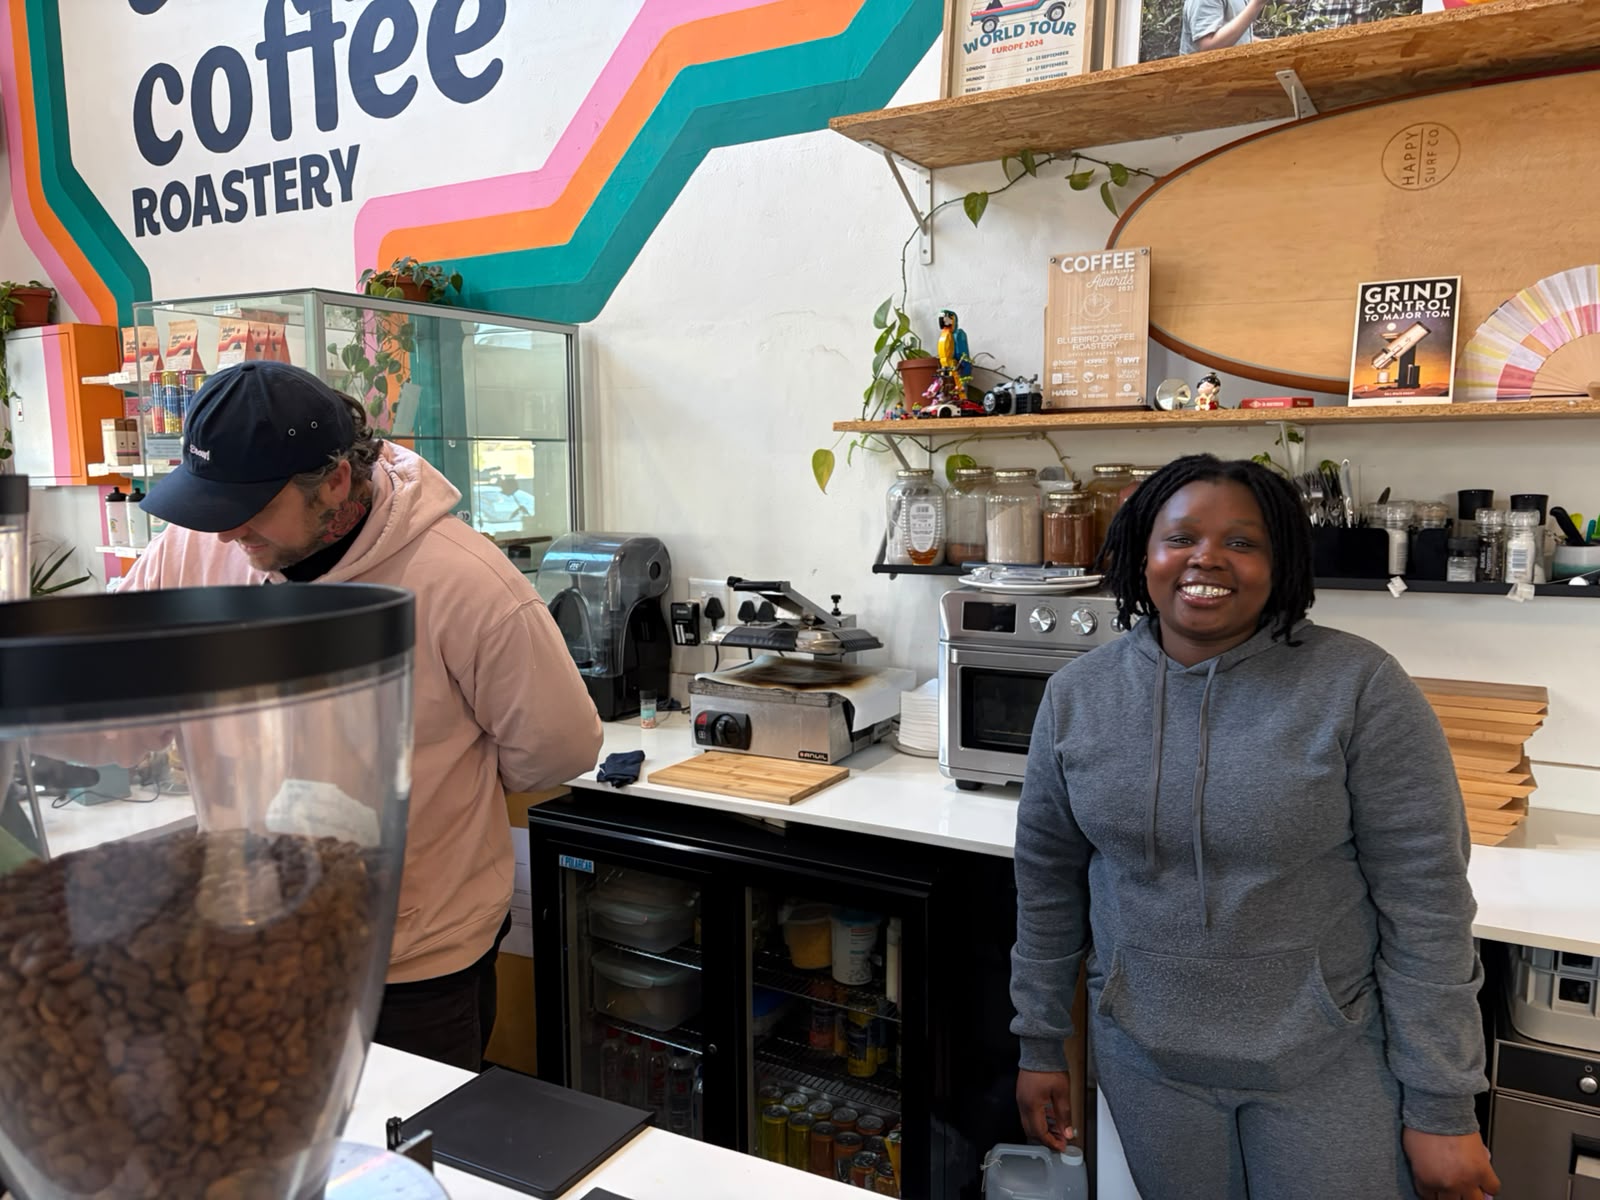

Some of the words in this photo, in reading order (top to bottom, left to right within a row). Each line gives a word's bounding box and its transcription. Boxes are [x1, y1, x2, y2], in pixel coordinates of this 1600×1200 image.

[963, 23, 1025, 55] WORLD
[1029, 20, 1077, 37] TOUR
[991, 42, 1023, 54] EUROPE
[1024, 39, 1044, 49] 2024
[1041, 50, 1069, 59] SEPTEMBER
[966, 64, 987, 72] LONDON
[1040, 60, 1068, 70] SEPTEMBER
[133, 0, 507, 167] coffee
[1040, 71, 1068, 80] SEPTEMBER
[1402, 132, 1418, 186] HAPPY
[1425, 151, 1437, 183] SURF
[131, 144, 361, 238] ROASTERY
[1060, 251, 1136, 274] COFFEE
[1086, 273, 1135, 291] Awards
[1365, 282, 1453, 303] GRIND
[1364, 299, 1451, 315] CONTROL
[1365, 314, 1379, 322] TO
[1382, 311, 1422, 321] MAJOR
[1425, 310, 1450, 318] TOM
[1056, 335, 1100, 345] BLUEBIRD
[1100, 332, 1135, 342] COFFEE
[1072, 341, 1119, 351] ROASTERY
